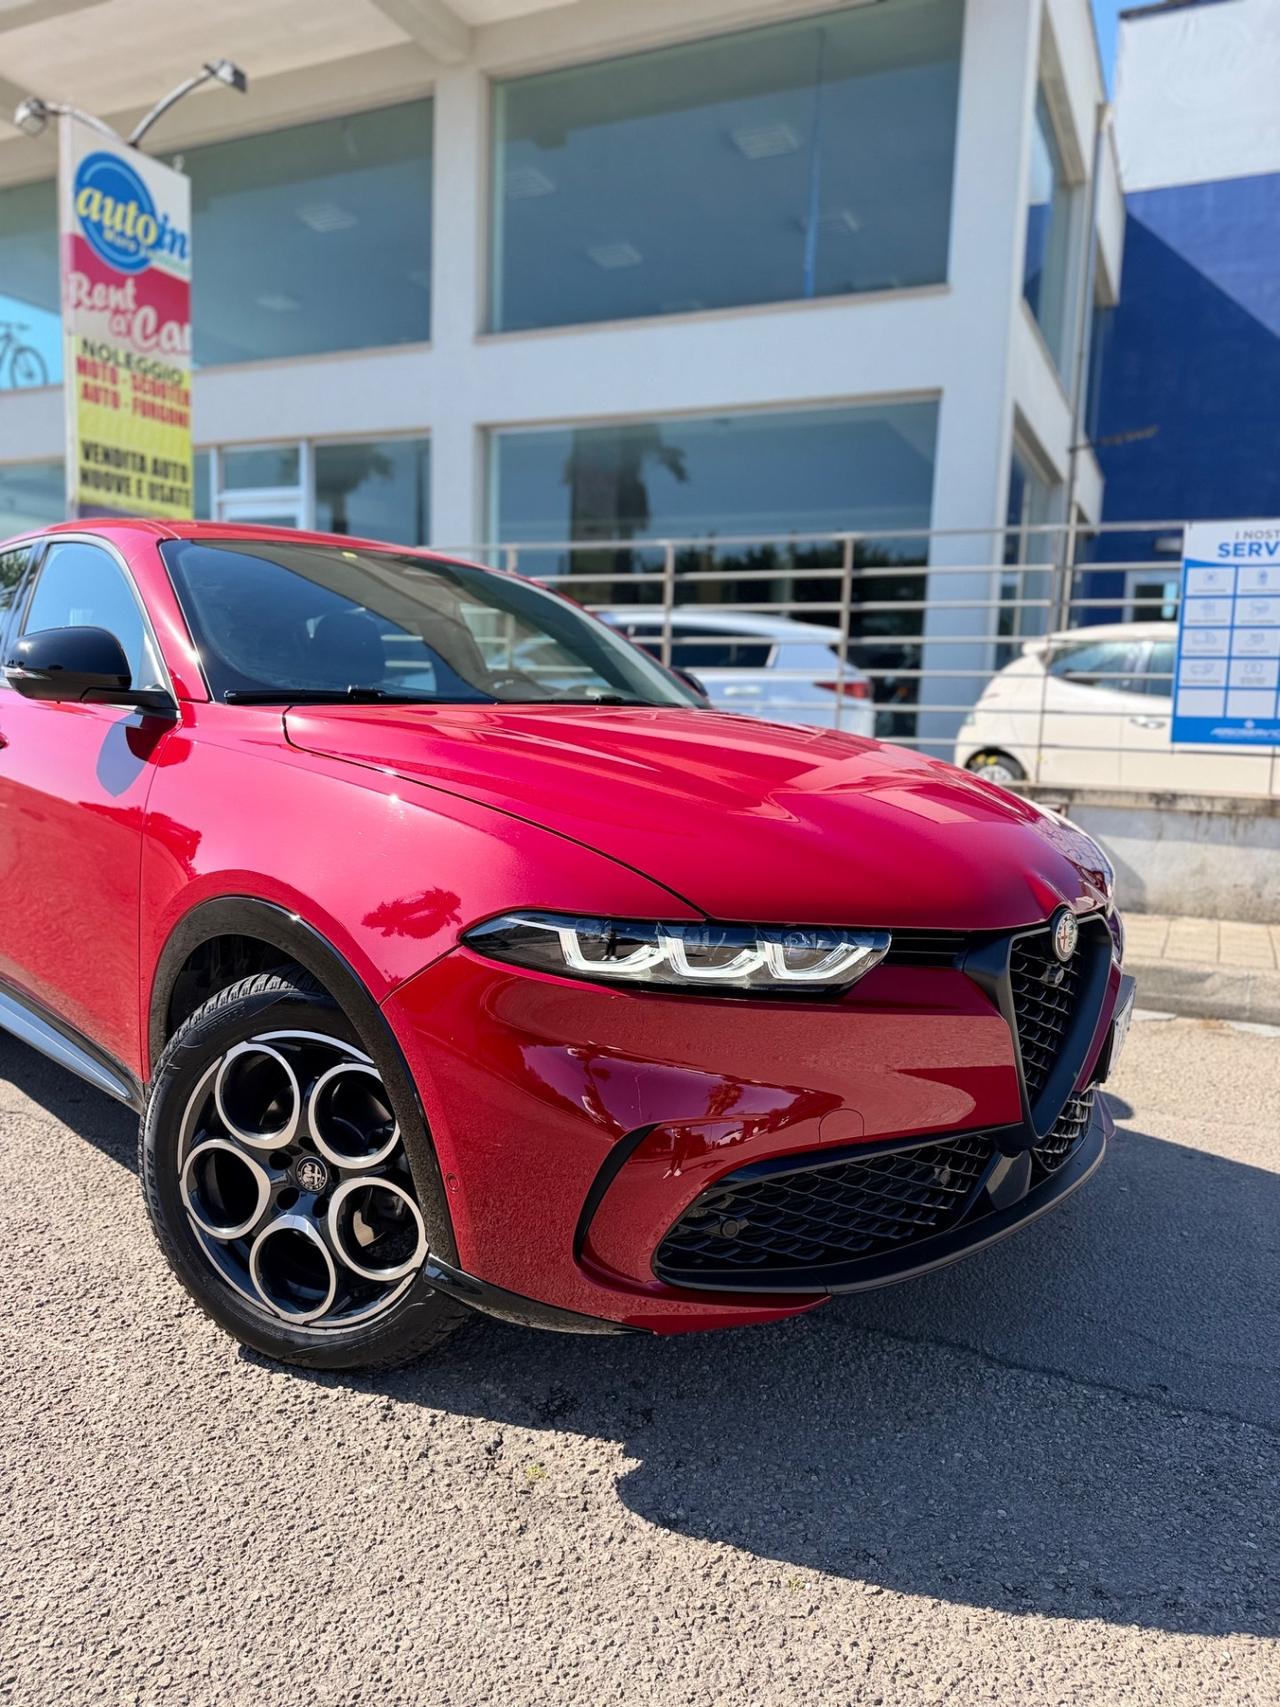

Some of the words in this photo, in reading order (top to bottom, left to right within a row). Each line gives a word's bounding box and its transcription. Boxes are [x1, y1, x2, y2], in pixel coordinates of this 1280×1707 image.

[67, 271, 137, 311] Rent
[76, 354, 118, 385] MOTO
[82, 338, 183, 386] NOLEGGIO
[82, 381, 120, 412] AUTO
[132, 396, 189, 429] FURGONI
[81, 439, 146, 475] VENDITA
[152, 457, 188, 484] AUTO
[81, 466, 130, 497] NUOVE
[135, 478, 143, 499] E
[1218, 541, 1280, 558] SERV
